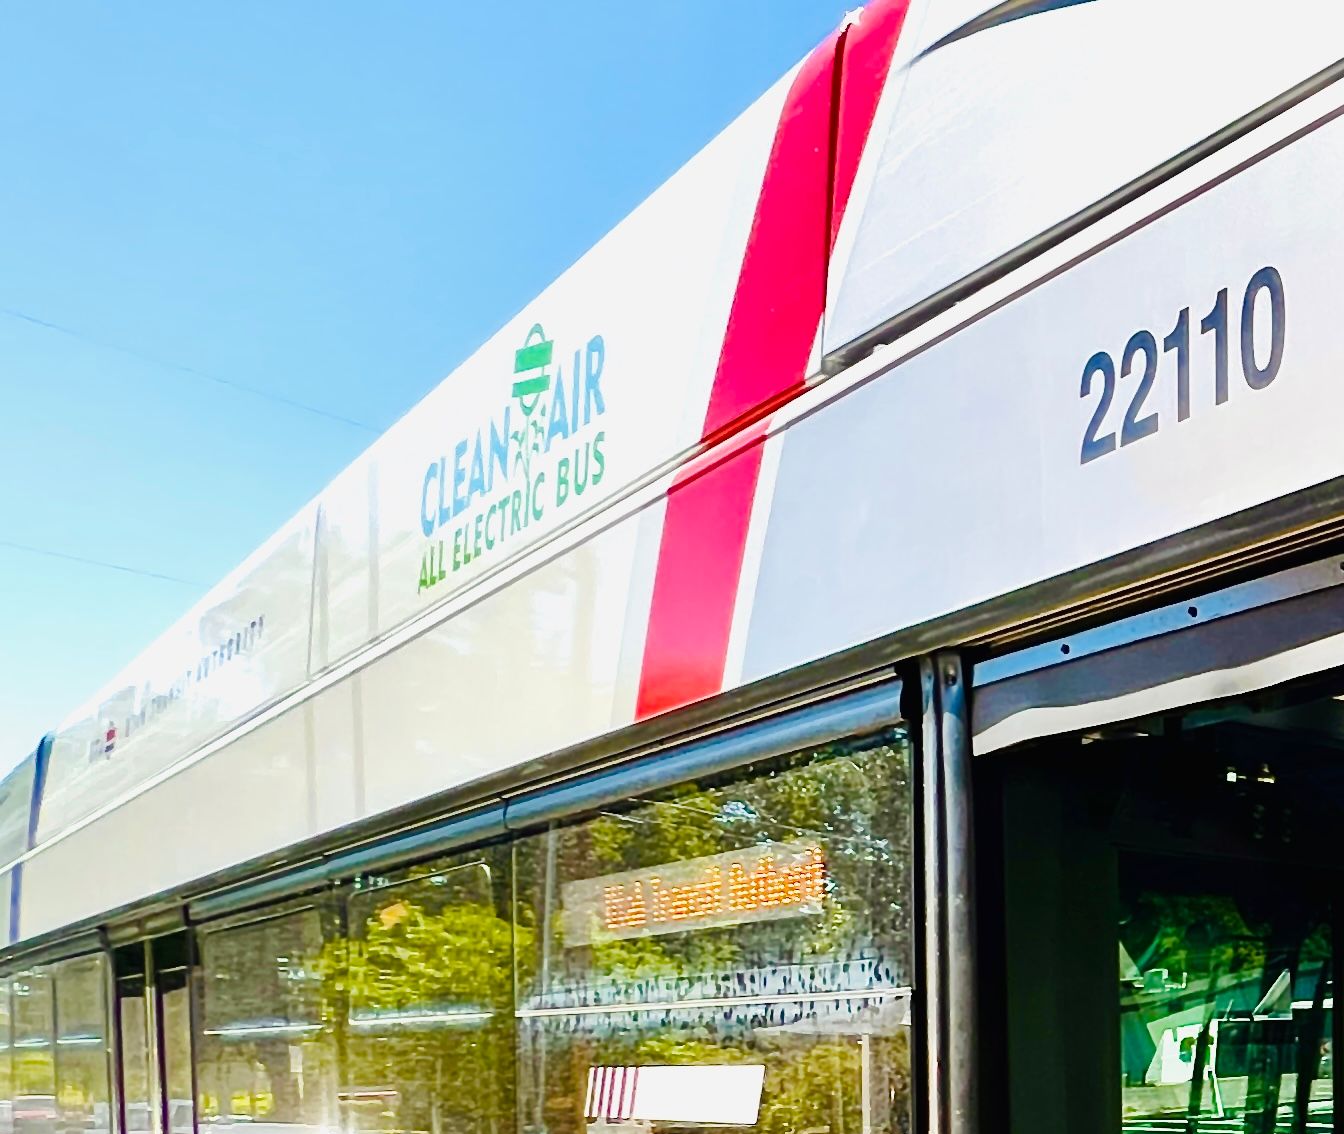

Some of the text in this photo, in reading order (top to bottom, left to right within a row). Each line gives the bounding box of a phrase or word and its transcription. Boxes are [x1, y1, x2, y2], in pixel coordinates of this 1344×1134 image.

[420, 334, 606, 538] CLEAN AIR
[1080, 265, 1287, 466] 22110
[417, 430, 606, 596] ALL ELECTRIC BUS
